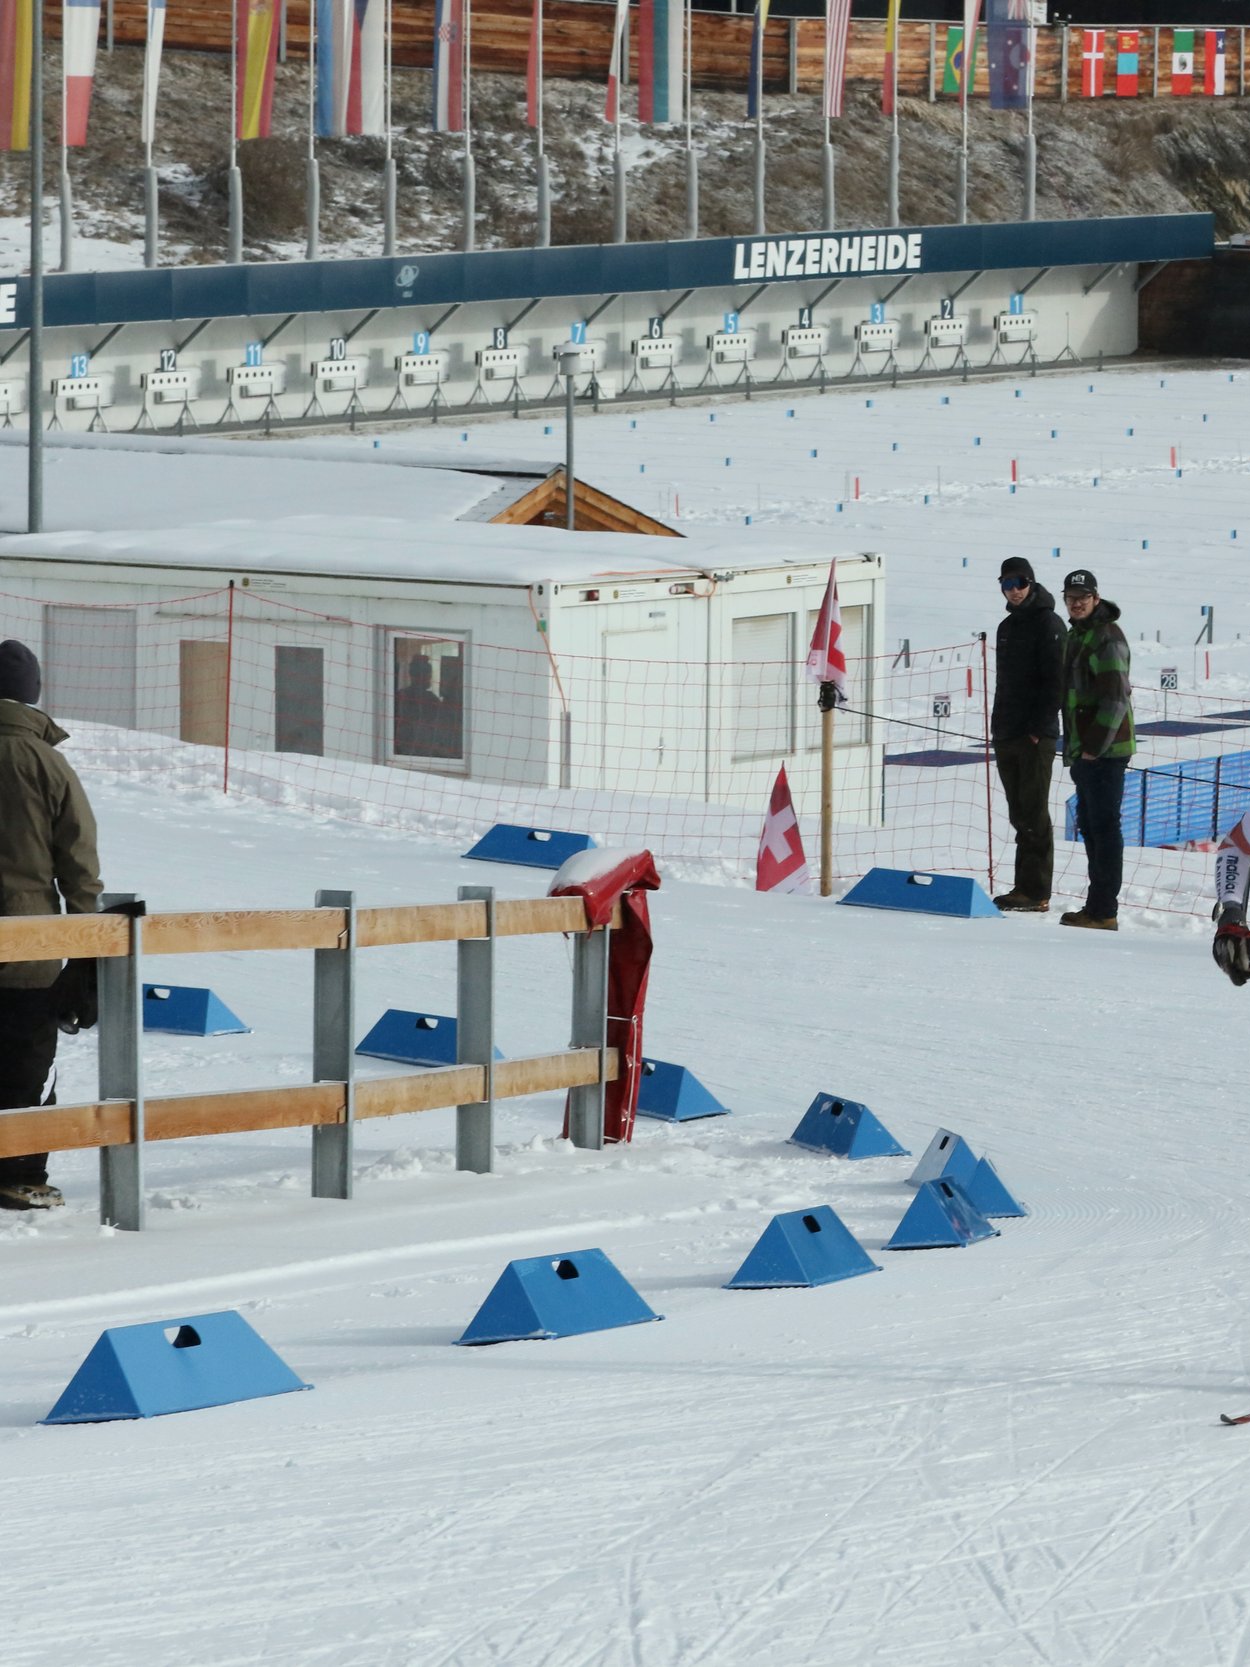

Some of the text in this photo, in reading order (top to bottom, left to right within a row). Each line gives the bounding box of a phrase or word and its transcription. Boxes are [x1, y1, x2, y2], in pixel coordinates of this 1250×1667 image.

[733, 233, 923, 280] LENZERHEIDE
[873, 304, 883, 323] 3
[943, 299, 953, 319] 2
[1012, 295, 1021, 314] 1
[652, 318, 661, 338] 6
[727, 313, 737, 334] 5
[800, 309, 810, 329] 4
[496, 328, 506, 348] 8
[574, 323, 584, 343] 7
[330, 338, 346, 360] 10
[416, 334, 427, 354] 9
[160, 350, 176, 371] 12
[247, 344, 262, 366] 11
[72, 356, 88, 377] 13
[1160, 675, 1176, 689] 28
[935, 702, 950, 717] 30
